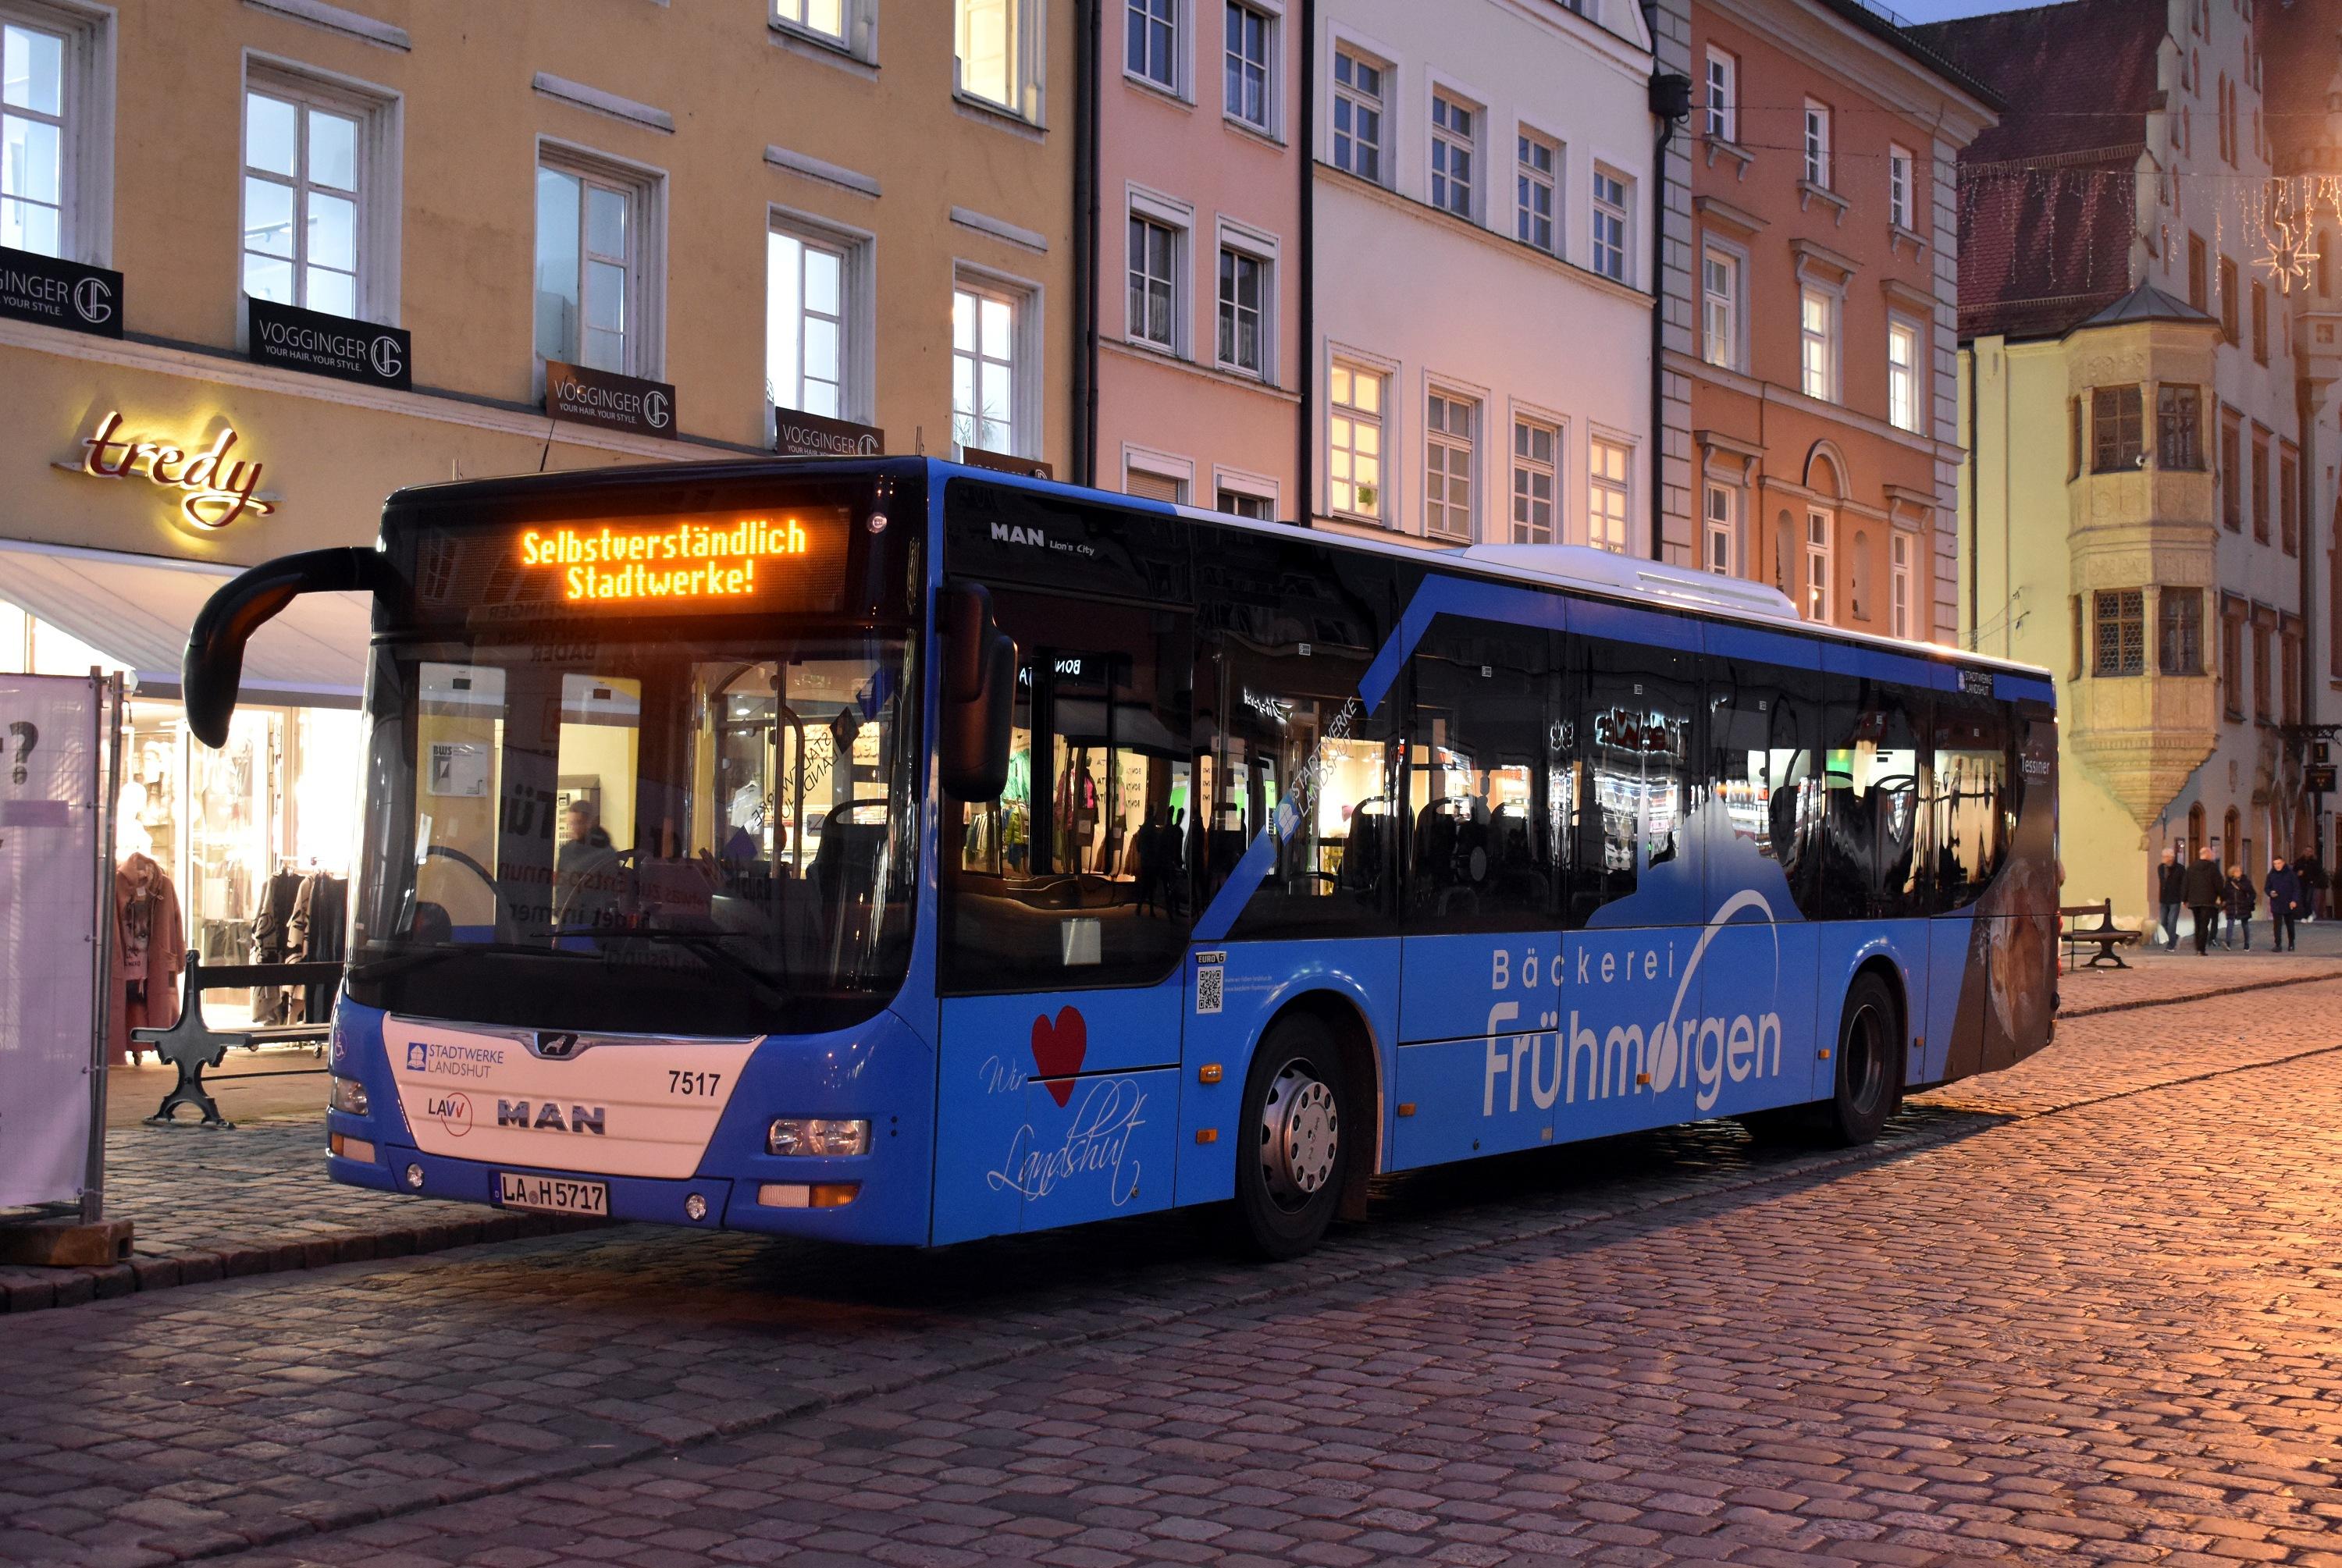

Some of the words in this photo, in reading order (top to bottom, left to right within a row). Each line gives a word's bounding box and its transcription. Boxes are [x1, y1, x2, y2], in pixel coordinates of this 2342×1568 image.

[3, 295, 30, 309] YOUR
[259, 318, 367, 361] VOGGINGER
[265, 344, 288, 357] YOUR
[290, 350, 311, 362] HAIR.
[312, 354, 336, 367] YOUR
[336, 358, 362, 372] STYLE.
[554, 380, 641, 414] VOGGINGER
[559, 402, 578, 413] YOUR
[578, 407, 597, 417] HAIR.
[597, 409, 616, 420] YOUR
[616, 413, 638, 425] STYLE.
[782, 424, 856, 455] VOGGINGER
[787, 444, 804, 454] YOUR
[82, 411, 276, 531] tredy
[522, 518, 807, 565] Selbstverständlich
[991, 521, 1045, 547] MAN
[1076, 544, 1094, 556] City
[567, 558, 755, 600] Stadtwerke!
[2020, 753, 2050, 775] Tessiner
[1198, 955, 1217, 963] EURO
[1219, 953, 1224, 962] 6
[1492, 940, 1674, 990] Bäckerei
[428, 1060, 491, 1079] LANDSHUT
[429, 1044, 504, 1064] STADTWERKE
[1483, 1001, 1782, 1117] Frühmorgen
[668, 1070, 721, 1097] 7517
[979, 1055, 1027, 1094] Wir
[497, 1098, 606, 1136] MAN
[987, 1079, 1148, 1207] Landshut
[503, 1176, 528, 1203] LA
[539, 1180, 552, 1206] H
[555, 1182, 603, 1211] 5717
